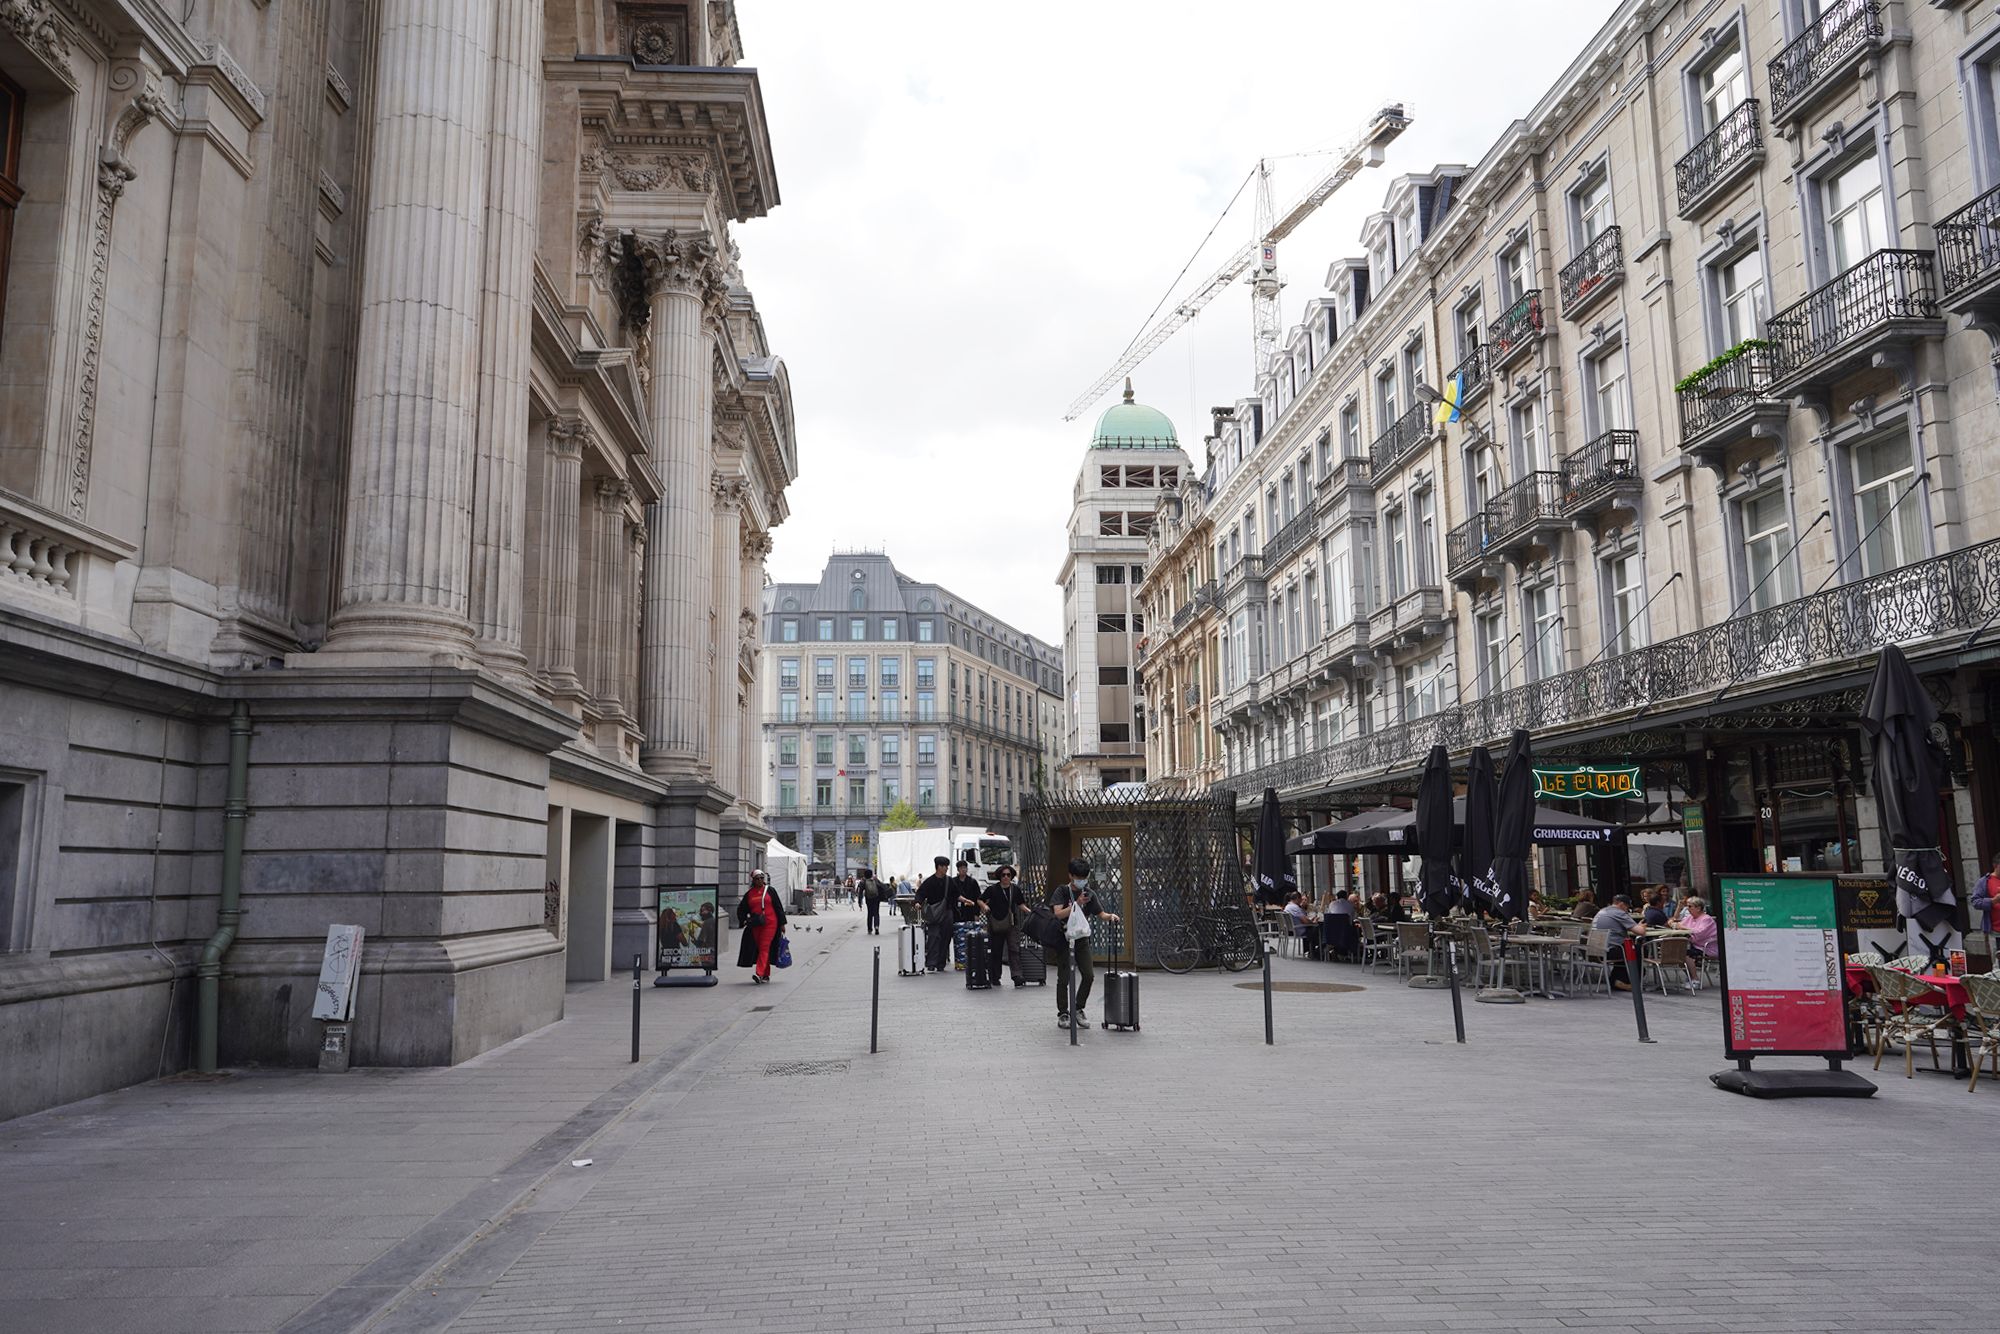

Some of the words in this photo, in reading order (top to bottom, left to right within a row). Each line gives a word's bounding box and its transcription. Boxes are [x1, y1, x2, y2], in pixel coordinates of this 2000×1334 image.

[1542, 775, 1566, 792] LE
[1573, 774, 1631, 793] CIRIO
[1760, 807, 1772, 818] 20
[1533, 828, 1600, 840] GRIMBERGEN
[1732, 995, 1745, 1041] BIANCHE
